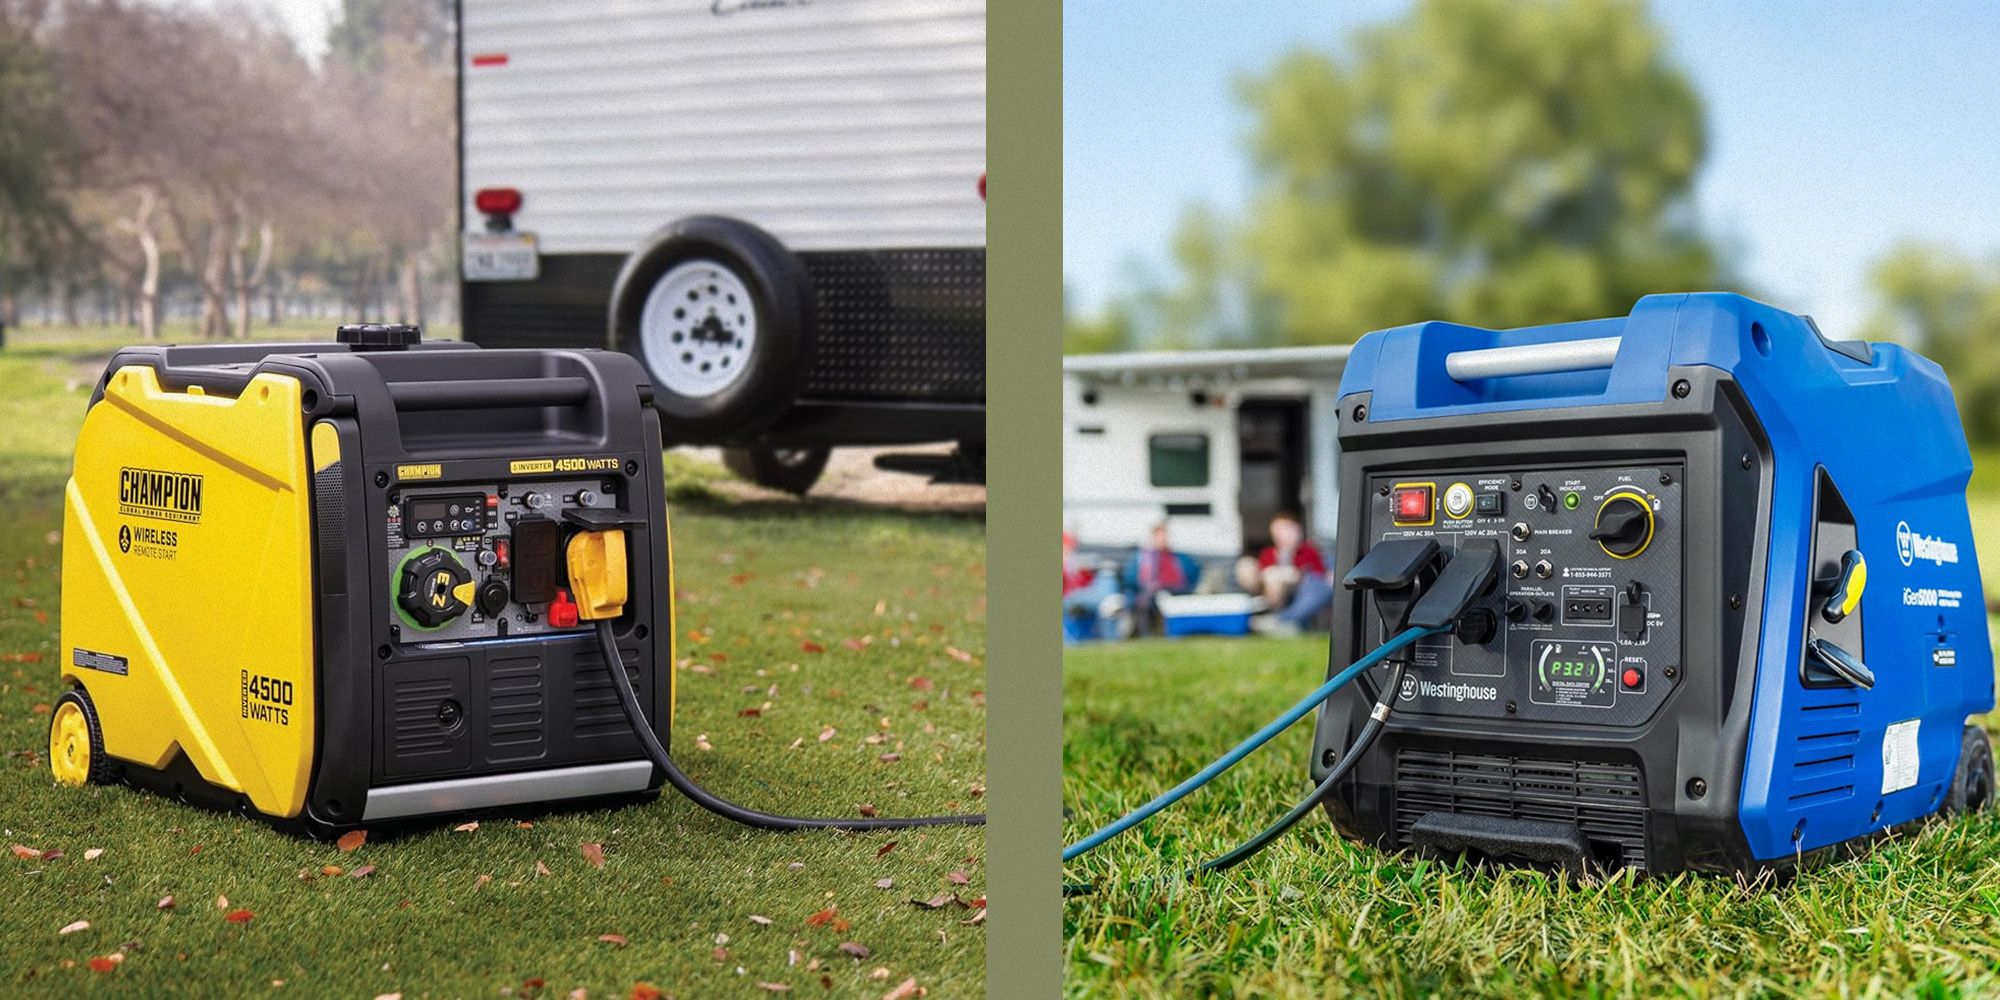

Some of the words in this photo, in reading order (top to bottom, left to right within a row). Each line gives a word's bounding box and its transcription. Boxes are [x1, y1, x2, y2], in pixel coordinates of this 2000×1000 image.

[518, 462, 552, 470] INVERTER
[555, 459, 586, 471] 4500
[586, 459, 618, 469] WATTS
[121, 470, 201, 512] CHAMPION
[120, 506, 141, 514] GLOBAL
[165, 513, 200, 522] EQUIPMENT
[134, 526, 177, 547] WIRELESS
[134, 545, 157, 559] REMOTE
[158, 549, 177, 561] START
[249, 675, 293, 706] 4500
[1420, 680, 1497, 701] Westinghouse
[250, 702, 288, 726] WATTS
